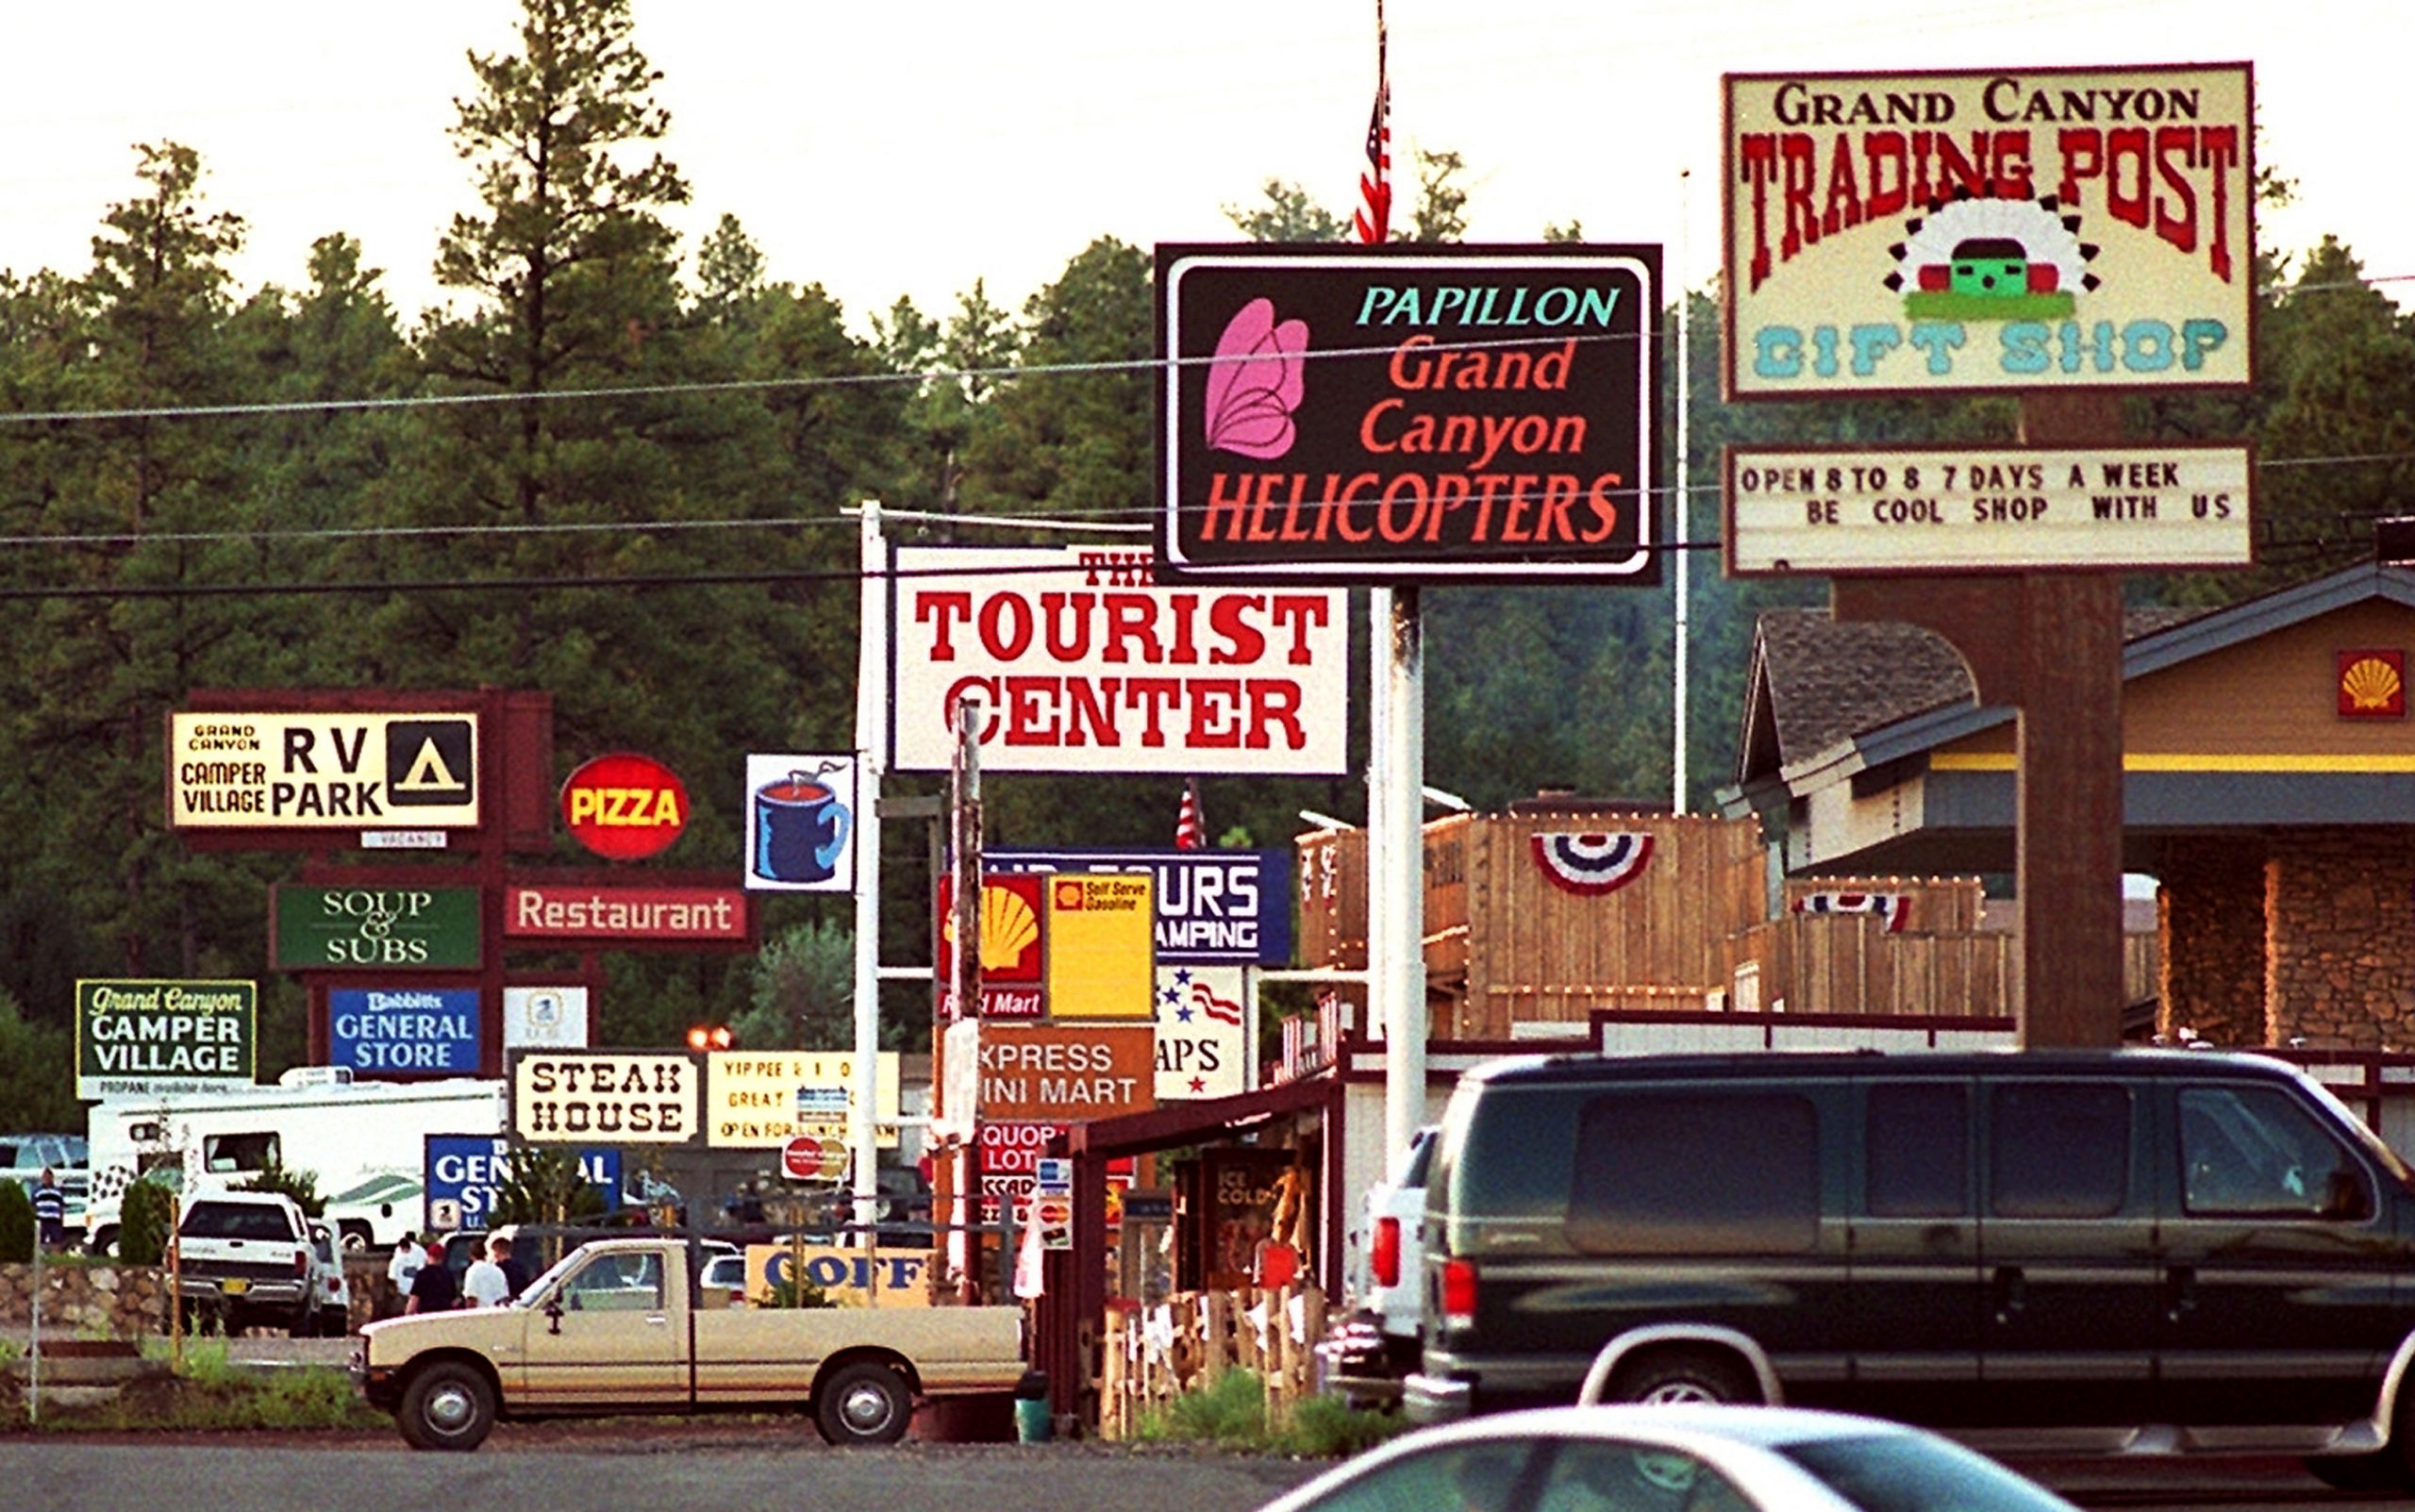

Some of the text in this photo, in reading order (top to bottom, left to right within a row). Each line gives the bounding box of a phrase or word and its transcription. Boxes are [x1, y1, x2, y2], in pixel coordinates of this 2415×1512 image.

[1774, 78, 2199, 125] GRAND CANYON
[1740, 125, 2238, 294] TRADING POST
[1356, 287, 1621, 327] PAPILLON
[1389, 334, 1577, 390] Grand
[1754, 318, 2228, 377] GIFT SHOP
[1360, 398, 1587, 471] Canyon
[1741, 462, 2180, 491] OPEN 8 TO 8 7 DAYS A WEEK
[1200, 474, 1622, 544] HELICOPTERS
[1806, 493, 2232, 524] BE COOL SHOP WITH US
[915, 590, 1329, 665] TOURIST
[944, 675, 1307, 751] CENTER
[189, 739, 260, 751] CANYON
[194, 725, 256, 738] GRAND
[181, 763, 266, 785] CAMPER
[183, 789, 265, 814] VILLAGE
[272, 783, 383, 817] PARK
[571, 789, 680, 826] PIZZA
[1087, 881, 1146, 896] Self Serve
[323, 891, 432, 917] SOUP
[519, 890, 732, 931] Restaurant
[1086, 897, 1137, 911] Gasoline
[358, 910, 397, 942] &
[1156, 921, 1258, 948] AMPING
[326, 938, 429, 964] SUBS
[89, 987, 242, 1017] Grand Canyon
[993, 993, 1040, 1014] Mart
[92, 1016, 242, 1043] CAMPER
[336, 1014, 474, 1039] GENERAL
[94, 1044, 239, 1072] VILLAGE
[355, 1041, 452, 1068] STORE
[980, 1043, 1113, 1072] XPRESS
[1156, 1038, 1220, 1072] APS
[531, 1061, 682, 1093] STEAK
[983, 1077, 1137, 1104] INI MART
[728, 1092, 783, 1107] GREAT
[531, 1102, 682, 1134] HOUSE
[721, 1122, 758, 1138] OPEN
[435, 1154, 613, 1185] GENAL
[989, 1150, 1036, 1170] LOT
[1217, 1188, 1268, 1205] COLD
